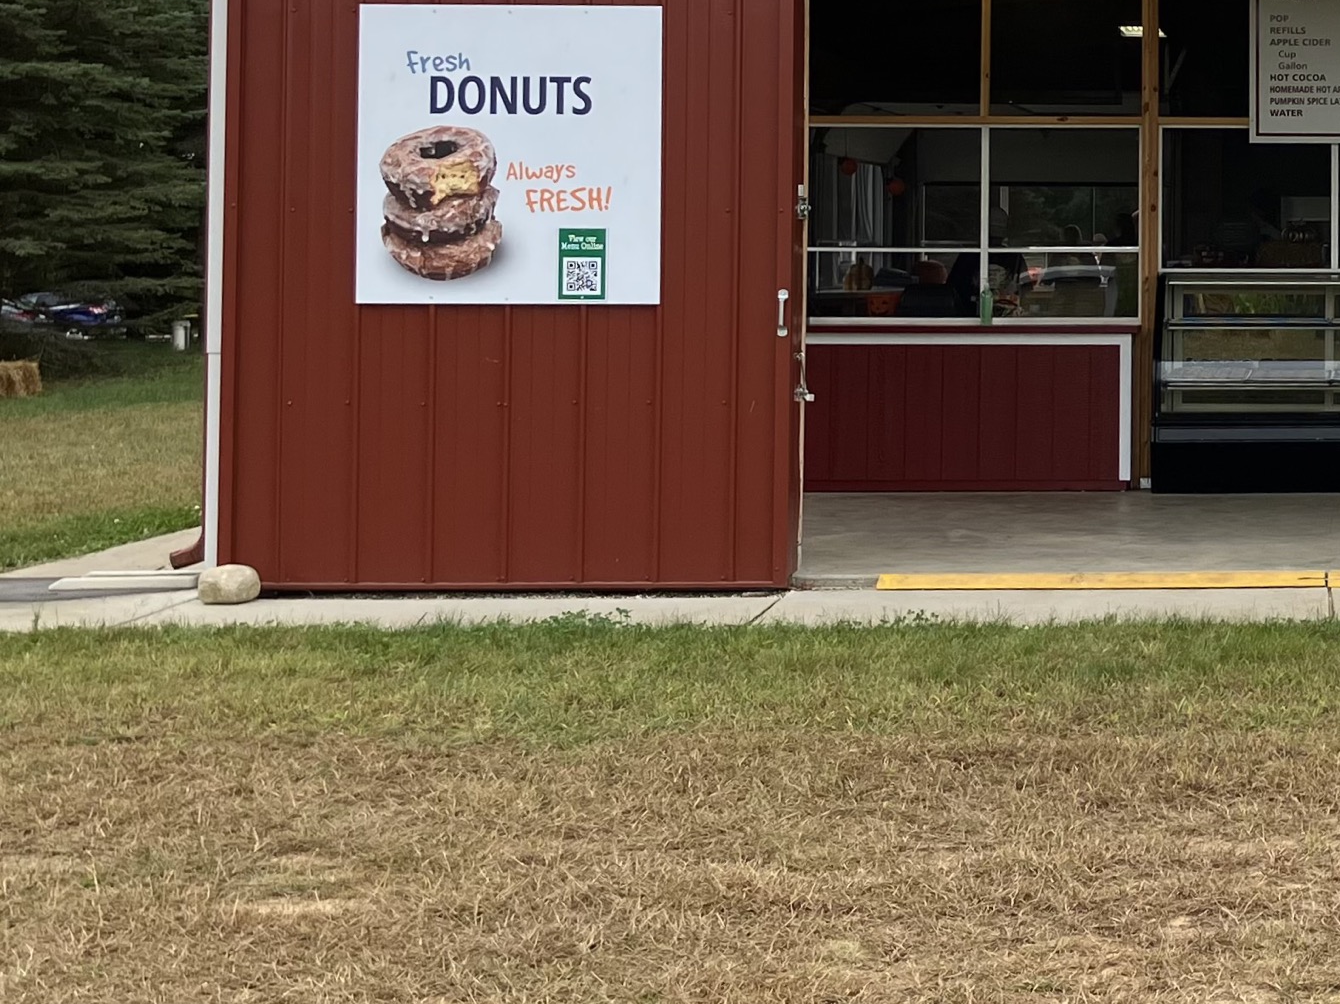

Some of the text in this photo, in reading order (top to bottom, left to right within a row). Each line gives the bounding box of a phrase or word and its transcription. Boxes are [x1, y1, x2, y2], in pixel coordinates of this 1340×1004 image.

[406, 50, 471, 74] Fresh
[1279, 50, 1296, 59] Cup
[1279, 62, 1307, 70] Gallon
[429, 75, 592, 116] DONUTS
[1270, 109, 1303, 117] WATER
[506, 161, 576, 184] Always
[525, 185, 614, 213] FRESH!
[561, 242, 604, 250] Menu Online
